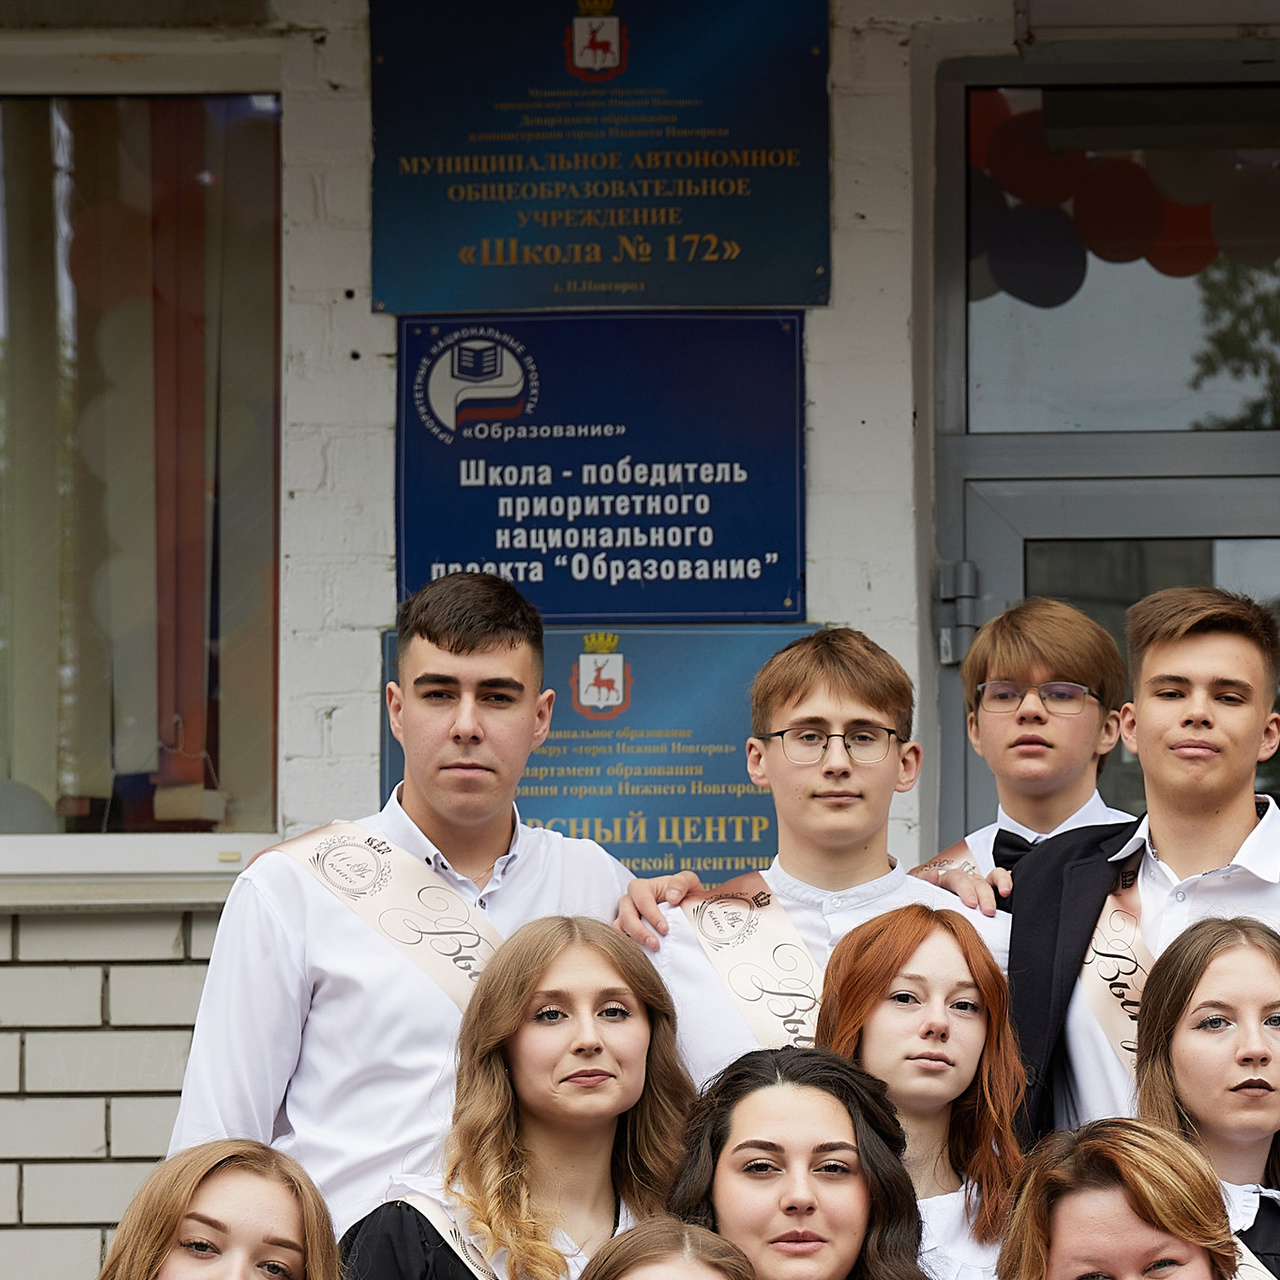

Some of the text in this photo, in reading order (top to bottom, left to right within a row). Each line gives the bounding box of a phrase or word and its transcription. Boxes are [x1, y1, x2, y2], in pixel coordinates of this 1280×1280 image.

[399, 149, 801, 176] МУНИЦИПАЛЬНОЕ АВТОНОМНОЕ
[446, 177, 752, 203] ОБЩЕОБРАЗОВАТЕЛЬНОЕ
[516, 207, 683, 229] УЧРЕЖДЕНИЕ
[458, 233, 742, 267] «Школа № 172»
[523, 354, 541, 416] ПРОЕКТЫ
[462, 422, 627, 443] «Образование»
[459, 459, 553, 487] Школа
[581, 456, 748, 488] победитель
[498, 493, 711, 522] приоритетного
[496, 525, 714, 554] национального
[606, 762, 703, 779] образования
[618, 780, 686, 796] Нижнего
[658, 815, 769, 849] ЦЕНТР
